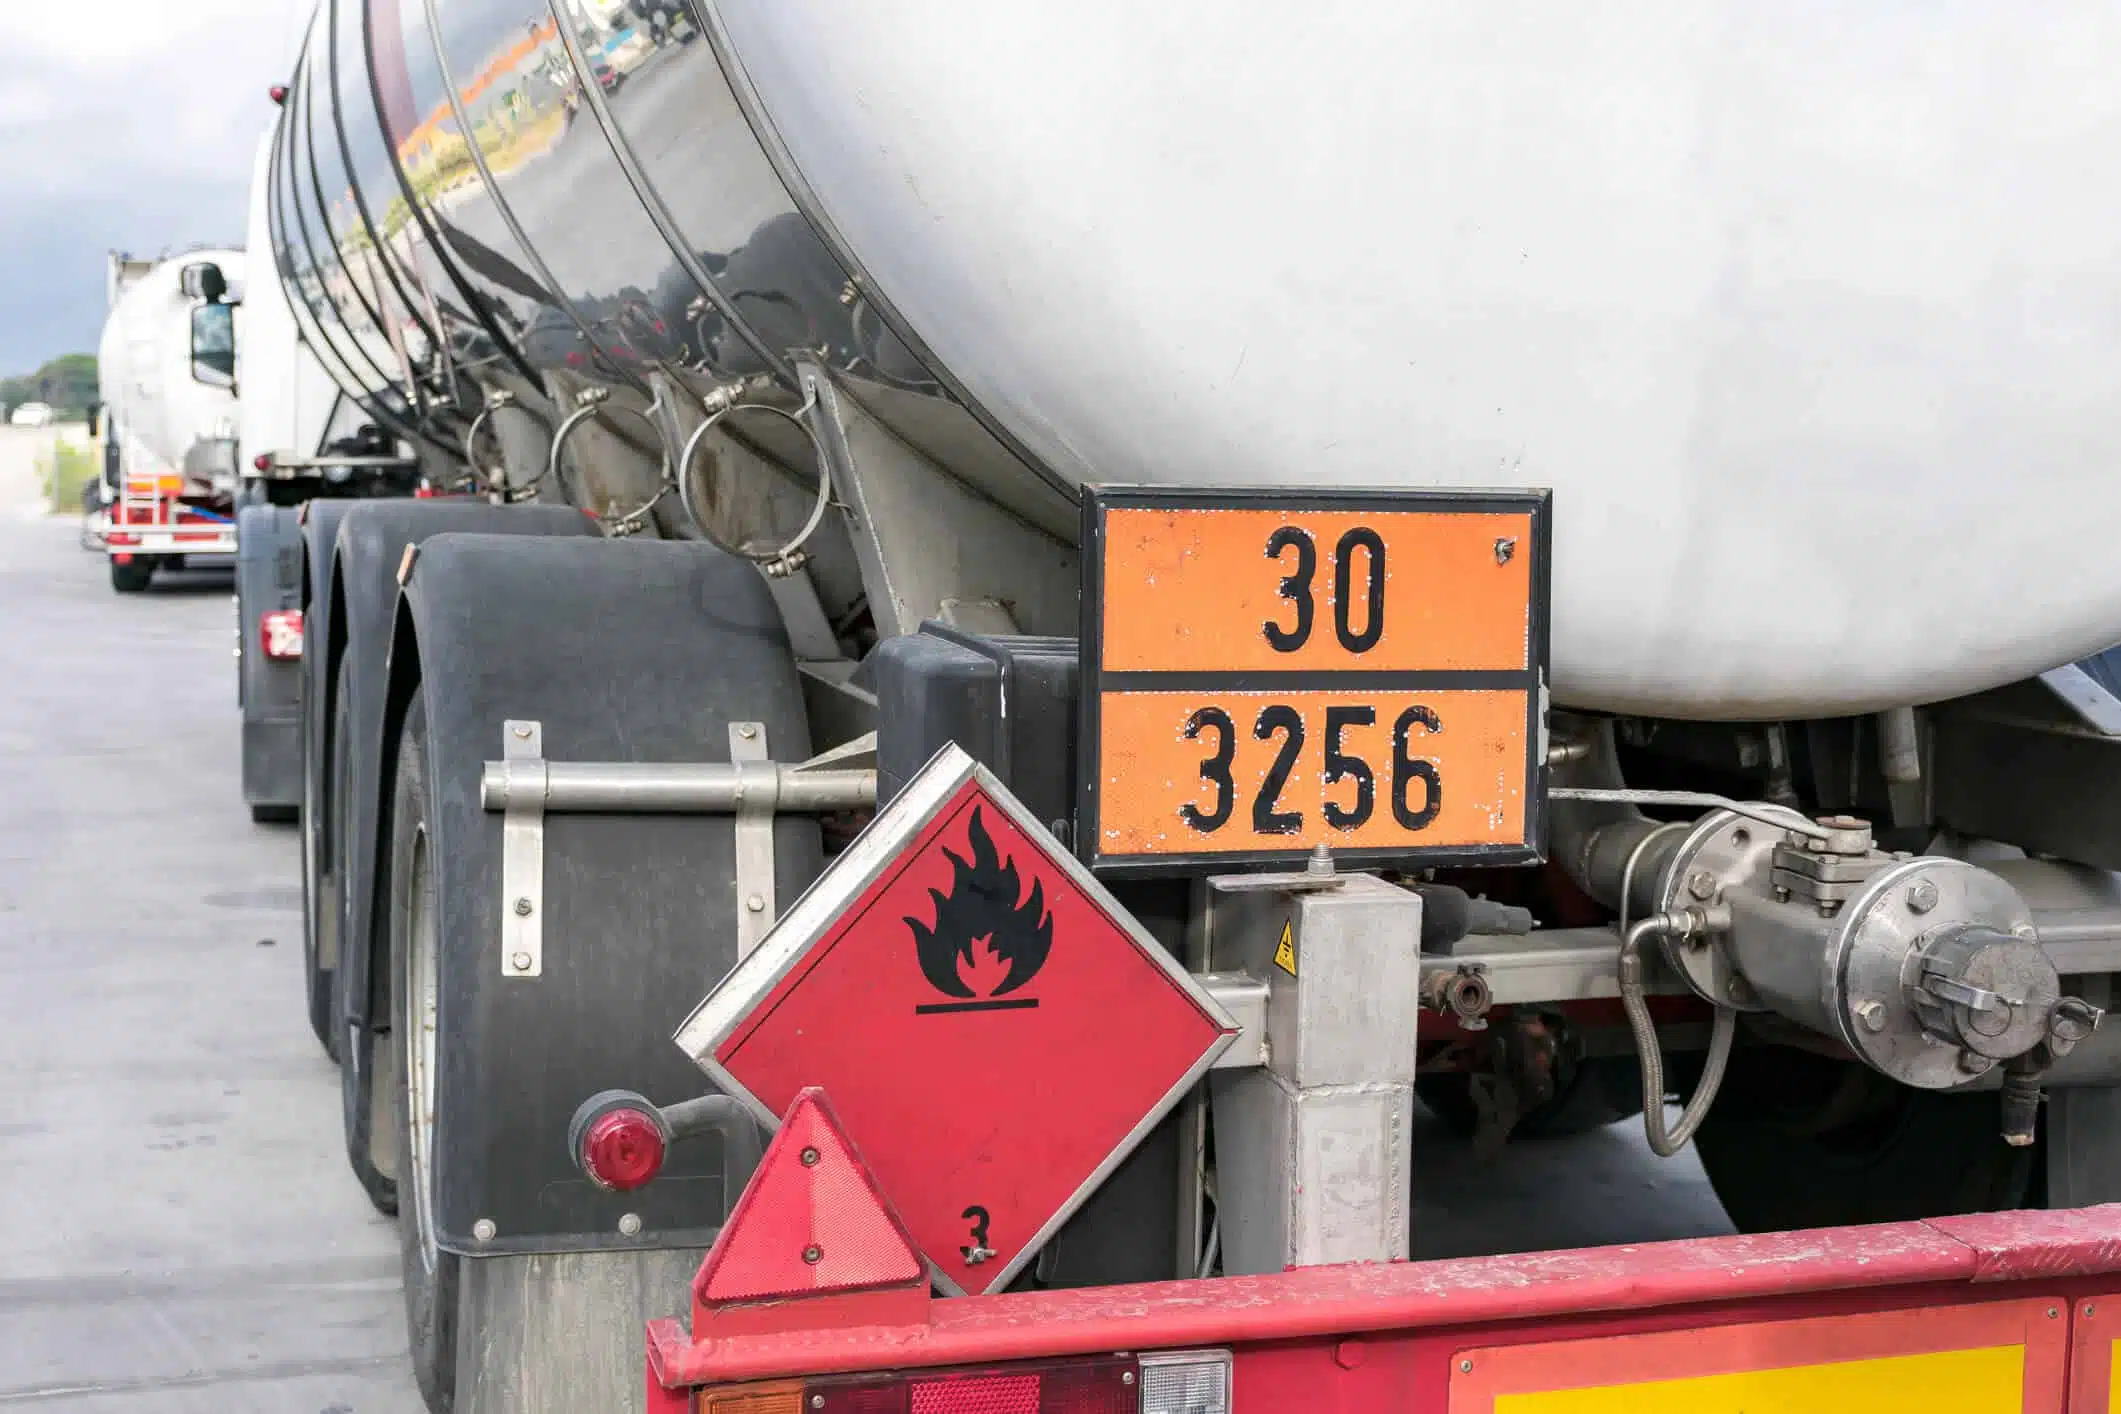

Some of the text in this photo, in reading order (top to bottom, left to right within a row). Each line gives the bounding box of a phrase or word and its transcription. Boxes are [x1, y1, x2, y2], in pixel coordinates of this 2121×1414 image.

[1263, 526, 1386, 654] 30
[1177, 705, 1442, 834] 3256
[960, 1205, 990, 1263] 3
